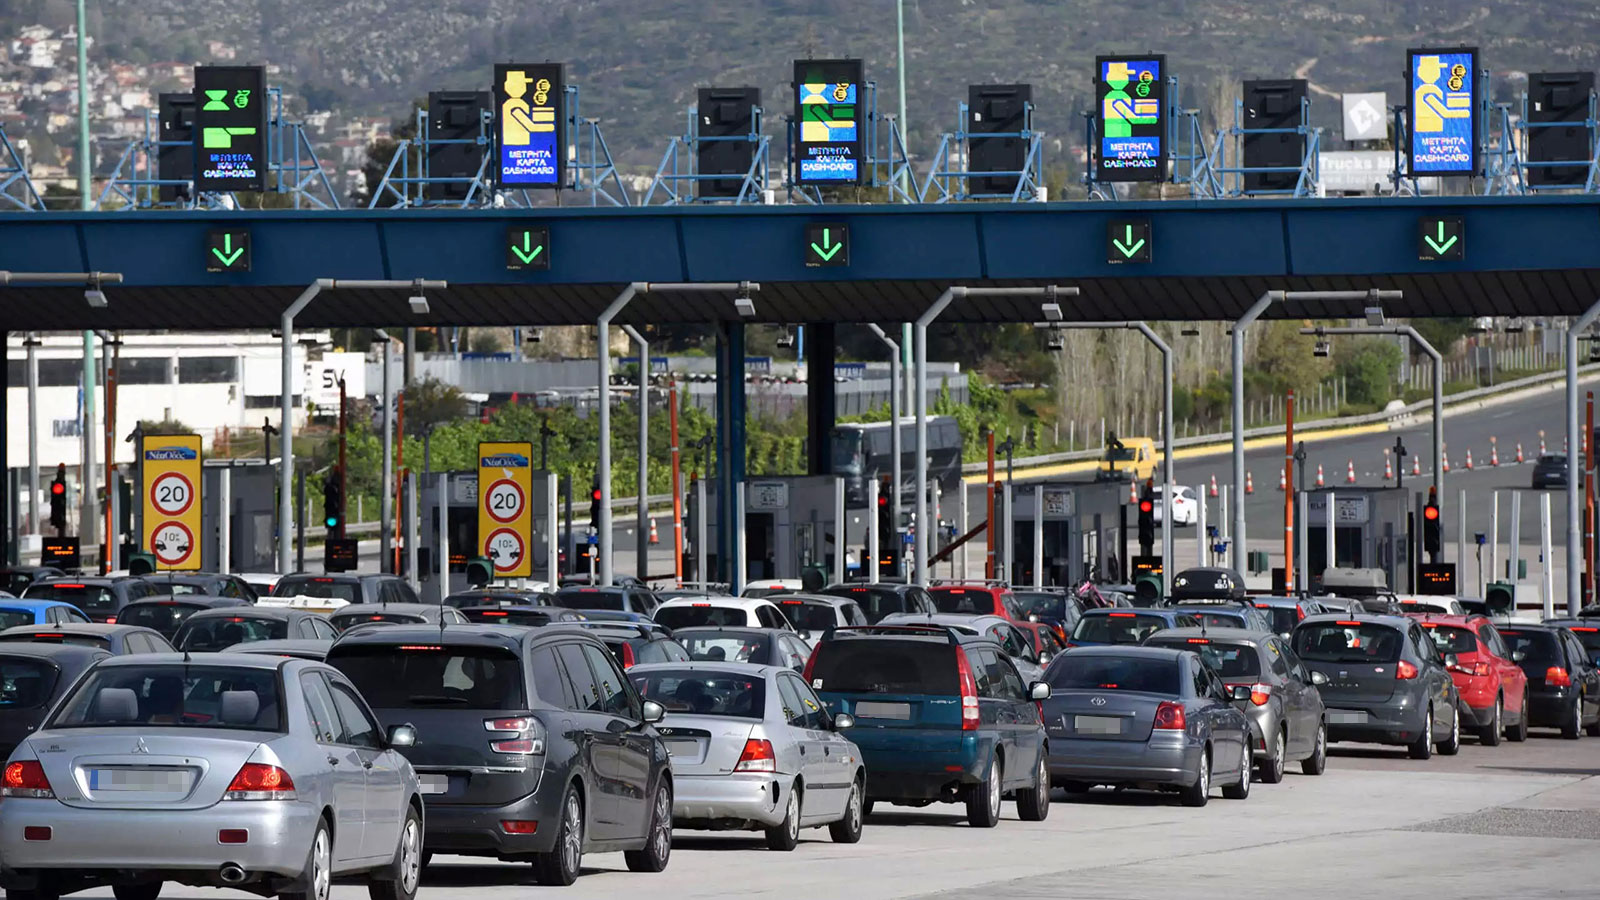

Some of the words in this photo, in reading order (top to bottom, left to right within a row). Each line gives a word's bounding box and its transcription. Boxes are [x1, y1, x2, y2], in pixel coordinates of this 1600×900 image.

[1117, 151, 1149, 159] ΚΑΡΤΑ
[1430, 145, 1461, 153] ΚΑΡΤΑ
[160, 486, 184, 502] 20
[494, 493, 516, 509] 20
